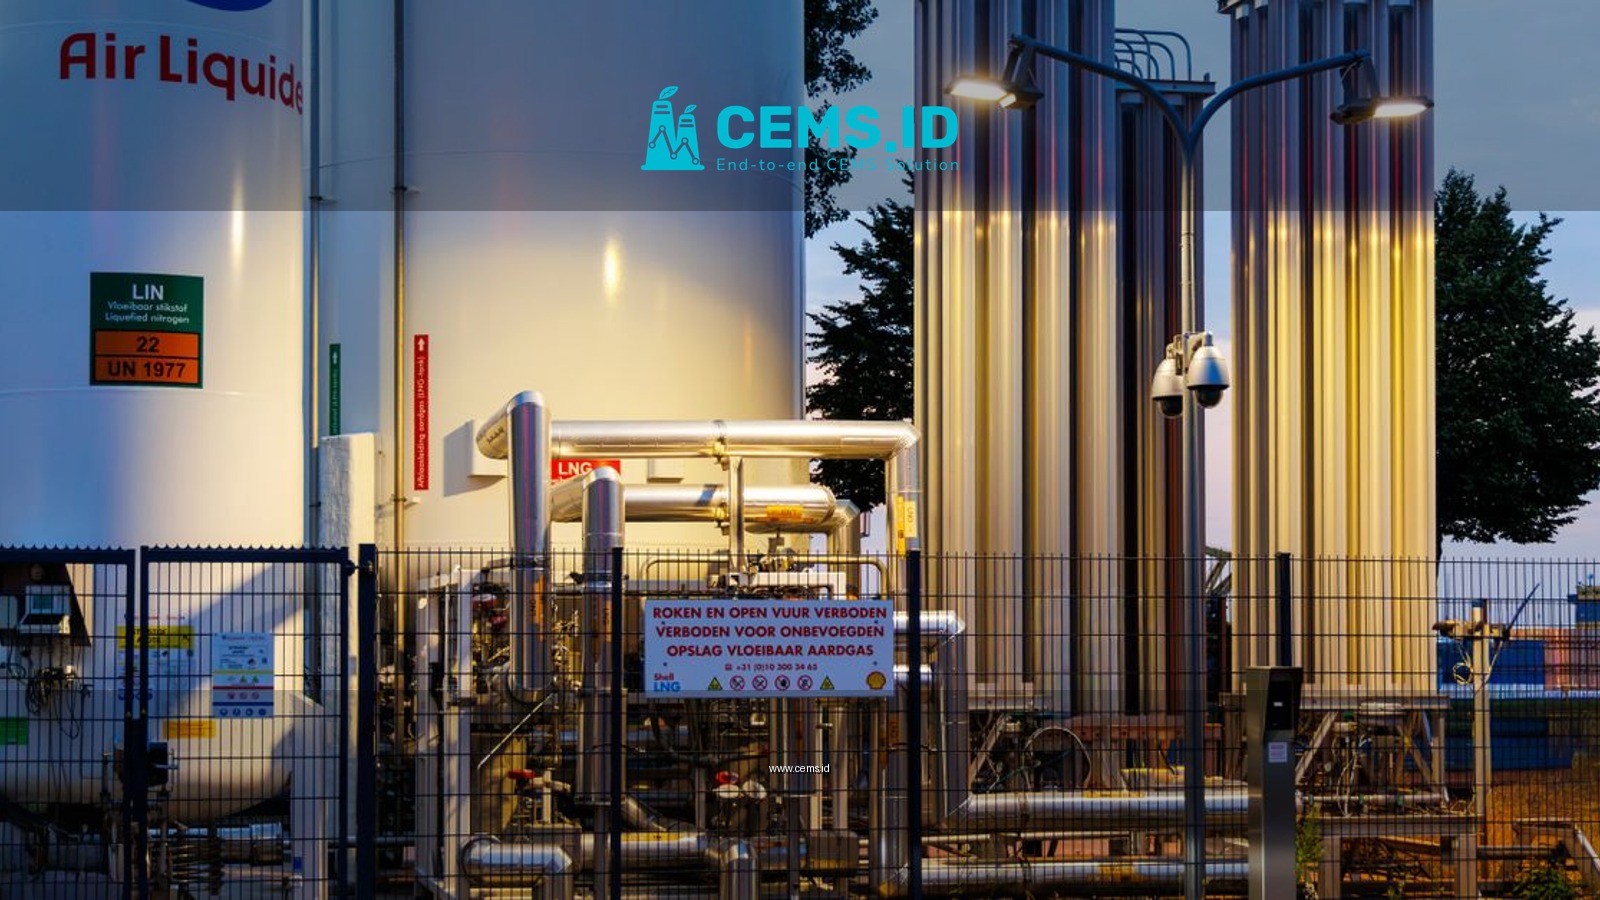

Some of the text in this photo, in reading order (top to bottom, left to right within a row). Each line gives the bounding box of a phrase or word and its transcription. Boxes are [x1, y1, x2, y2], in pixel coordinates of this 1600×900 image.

[60, 33, 303, 115] Air Liquide
[132, 283, 164, 301] LIN
[155, 303, 188, 313] stikstof
[105, 312, 190, 325] Liquefied nitrogen
[136, 336, 160, 353] 22
[108, 361, 187, 379] UN 1977
[558, 461, 592, 476] LNG
[653, 607, 887, 619] ROKEN EN OPEN VUUR VERBODEN
[656, 626, 884, 638] VERBODEN VOOR ONBEVOEGDEN
[666, 645, 874, 657] OPSLAG VLOEIBAAR AARDGAS
[653, 672, 675, 681] Shell
[653, 681, 681, 692] LNG
